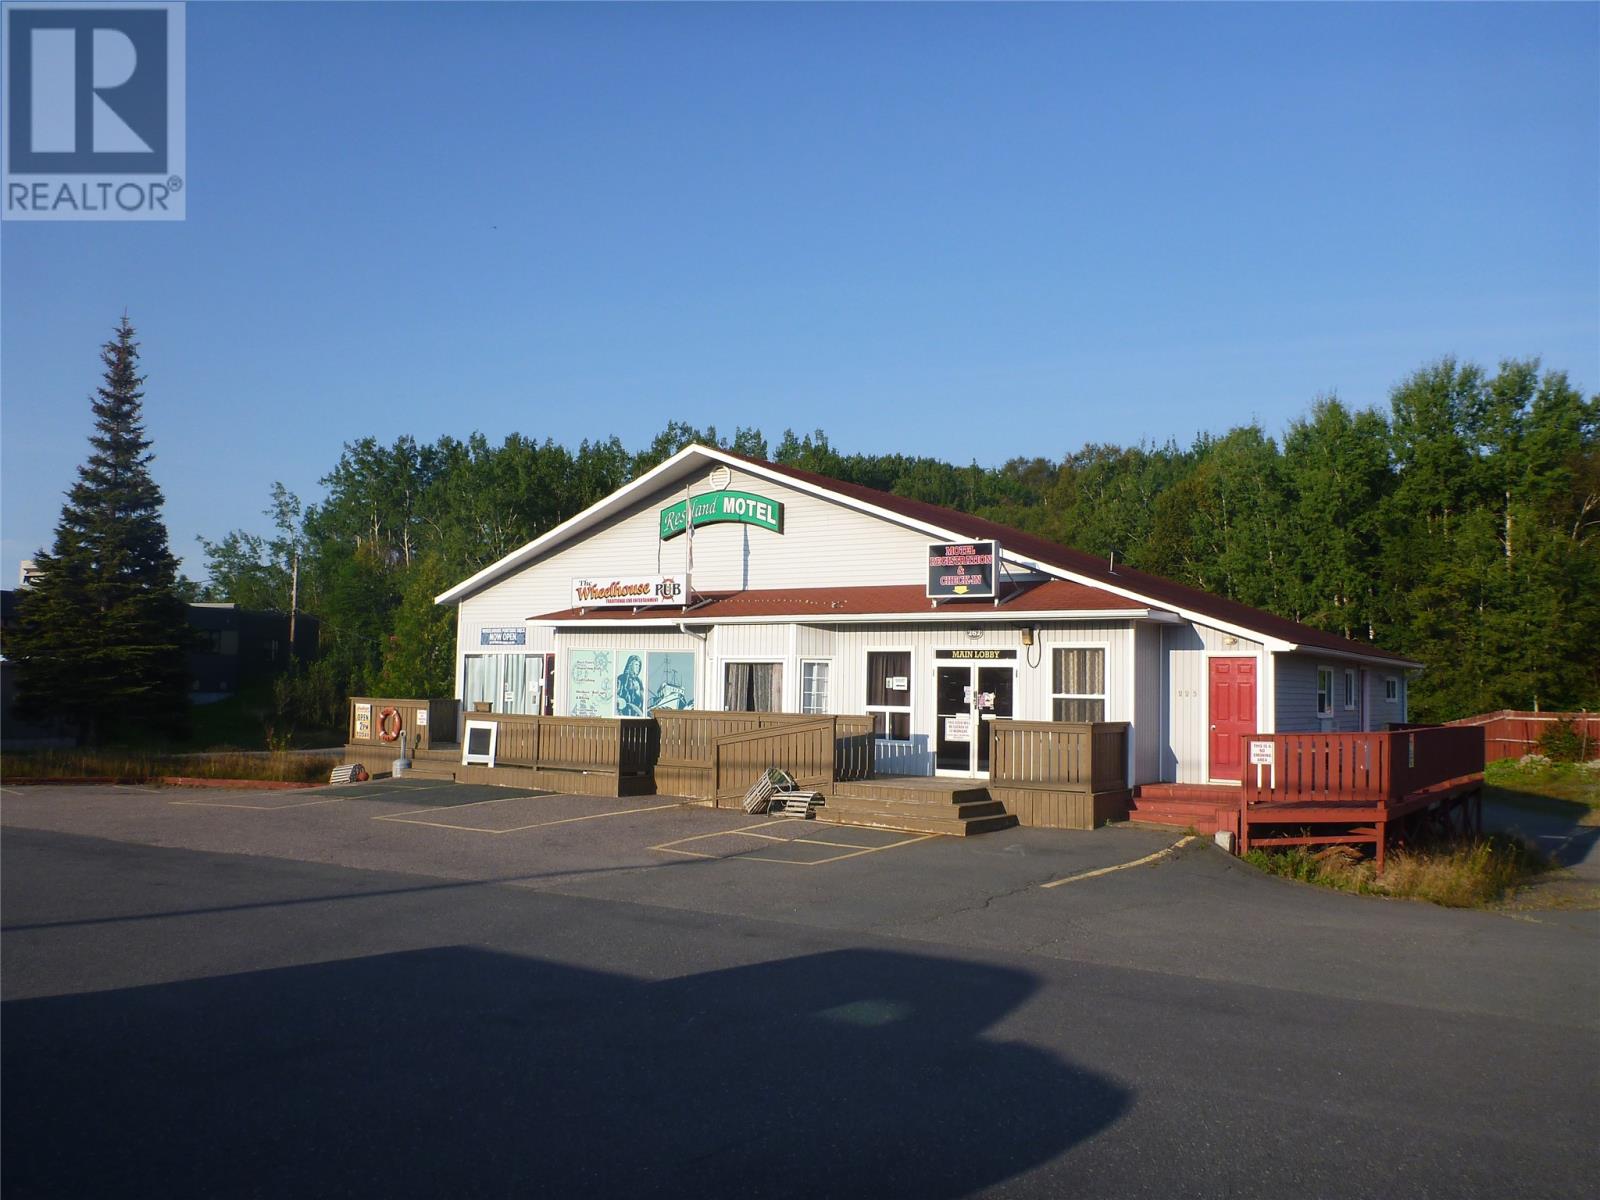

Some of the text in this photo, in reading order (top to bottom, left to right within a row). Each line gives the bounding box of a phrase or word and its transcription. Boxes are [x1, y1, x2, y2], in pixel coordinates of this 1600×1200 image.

[664, 495, 776, 531] Resland MOTEL
[945, 545, 976, 556] MOTEL
[929, 555, 992, 567] REGISTRATION
[956, 565, 965, 575] &
[940, 575, 982, 586] CHECK-IN
[576, 582, 681, 600] Wheelhouse PUB
[489, 632, 517, 641] NOW OPEN
[952, 650, 1000, 659] MAIN LOBBY
